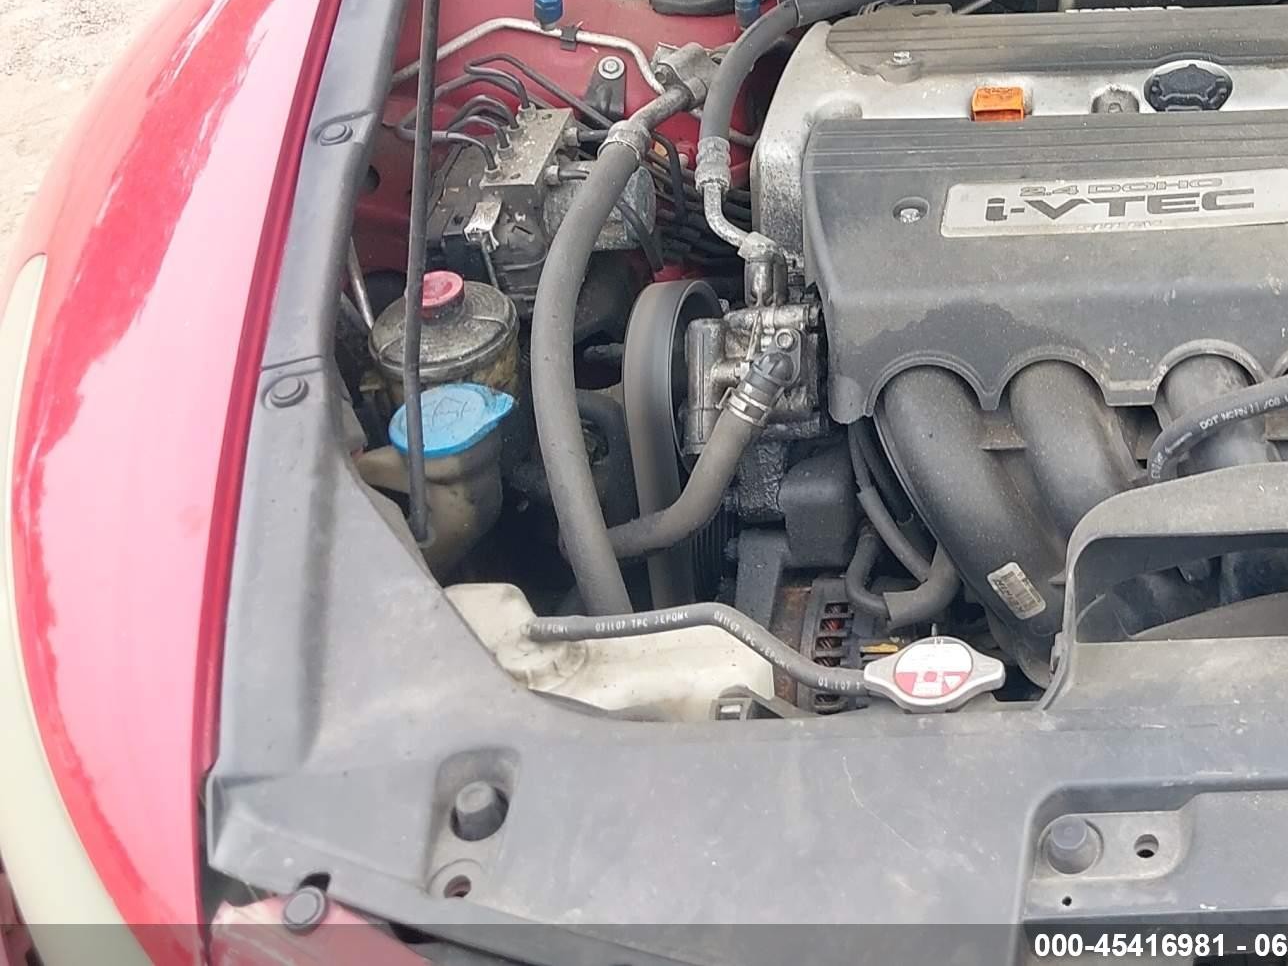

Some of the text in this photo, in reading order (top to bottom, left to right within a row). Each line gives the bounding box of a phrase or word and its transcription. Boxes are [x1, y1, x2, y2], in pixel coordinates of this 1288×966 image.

[1020, 177, 1223, 197] 2.4 DOHC
[985, 188, 1255, 222] i-VTEC
